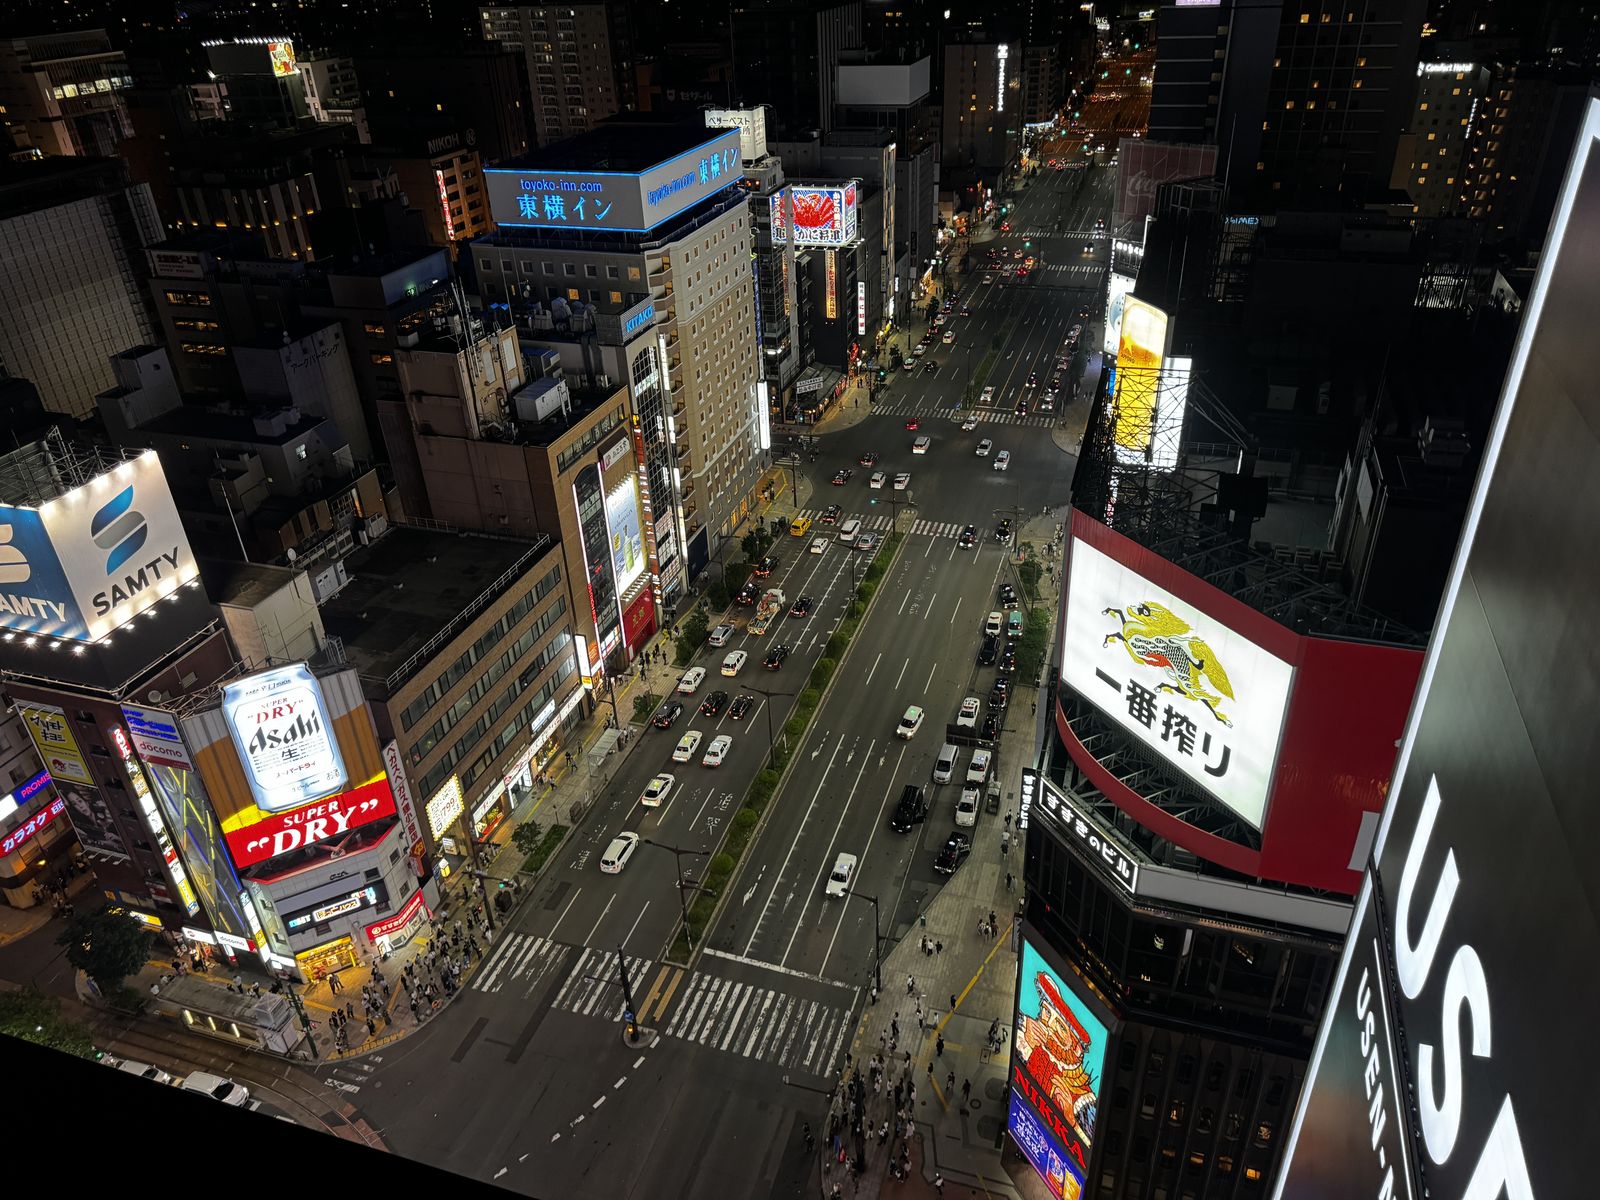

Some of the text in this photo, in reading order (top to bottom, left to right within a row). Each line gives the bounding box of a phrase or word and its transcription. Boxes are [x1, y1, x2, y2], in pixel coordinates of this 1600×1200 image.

[1426, 63, 1473, 72] Comfort Hotel
[427, 132, 460, 154] NIKOH
[698, 146, 740, 186] 東横イン
[520, 178, 603, 194] toyoko-inn.com
[647, 170, 696, 206] toyoko-inn.com
[516, 193, 613, 223] 東横イン
[625, 304, 653, 333] KITAKO
[92, 546, 180, 617] SAMTY
[261, 698, 288, 710] SUPER
[30, 716, 64, 732] マツモト
[41, 729, 66, 743] キヨシ
[249, 709, 321, 755] Asahi
[1095, 667, 1232, 778] 一番搾り
[140, 741, 183, 758] docomo
[281, 748, 300, 761] 生
[283, 800, 339, 828] SUPER
[2, 812, 47, 853] カラオケ
[1046, 791, 1130, 879] すすきのビル
[220, 935, 246, 948] docomo
[1014, 1065, 1087, 1170] NIKKA
